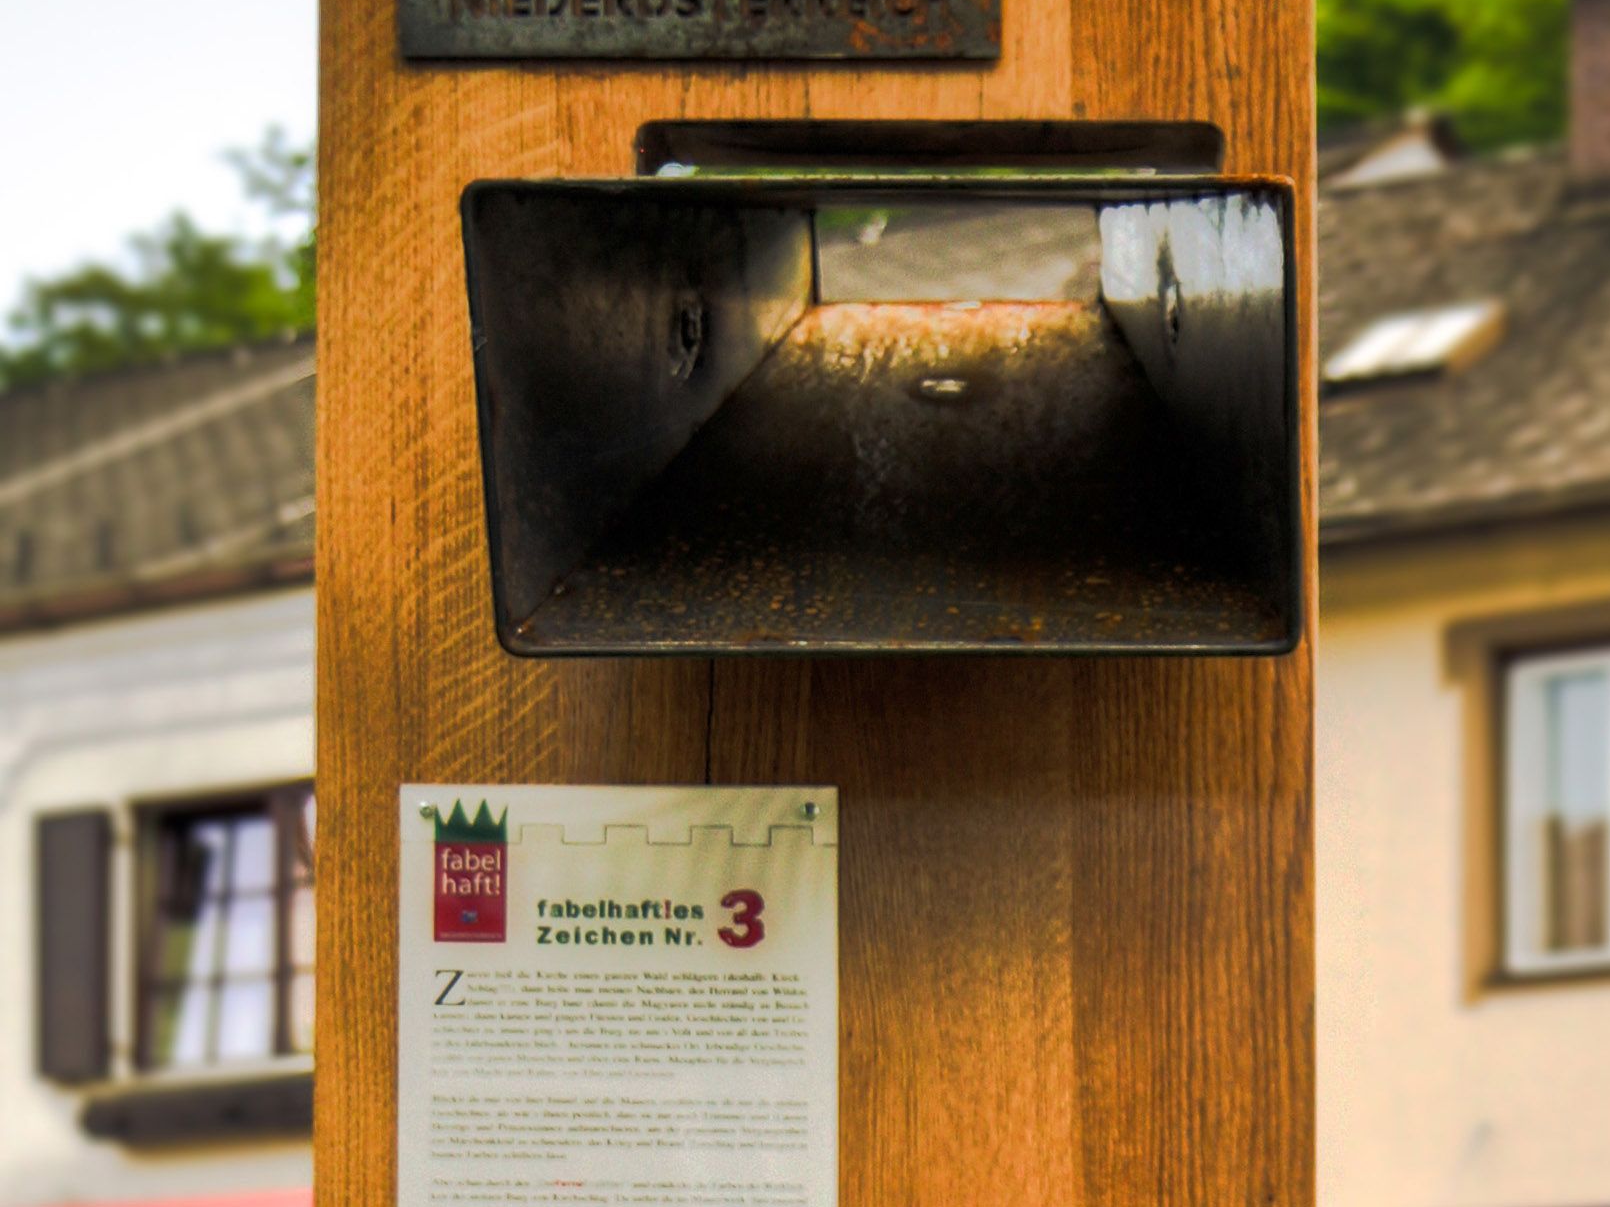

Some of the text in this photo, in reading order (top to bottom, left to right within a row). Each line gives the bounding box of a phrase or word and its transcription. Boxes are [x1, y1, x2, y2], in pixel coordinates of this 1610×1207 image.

[440, 848, 501, 872] fabel
[440, 872, 502, 896] haft!
[536, 888, 766, 949] Zeichen Nr. 3
